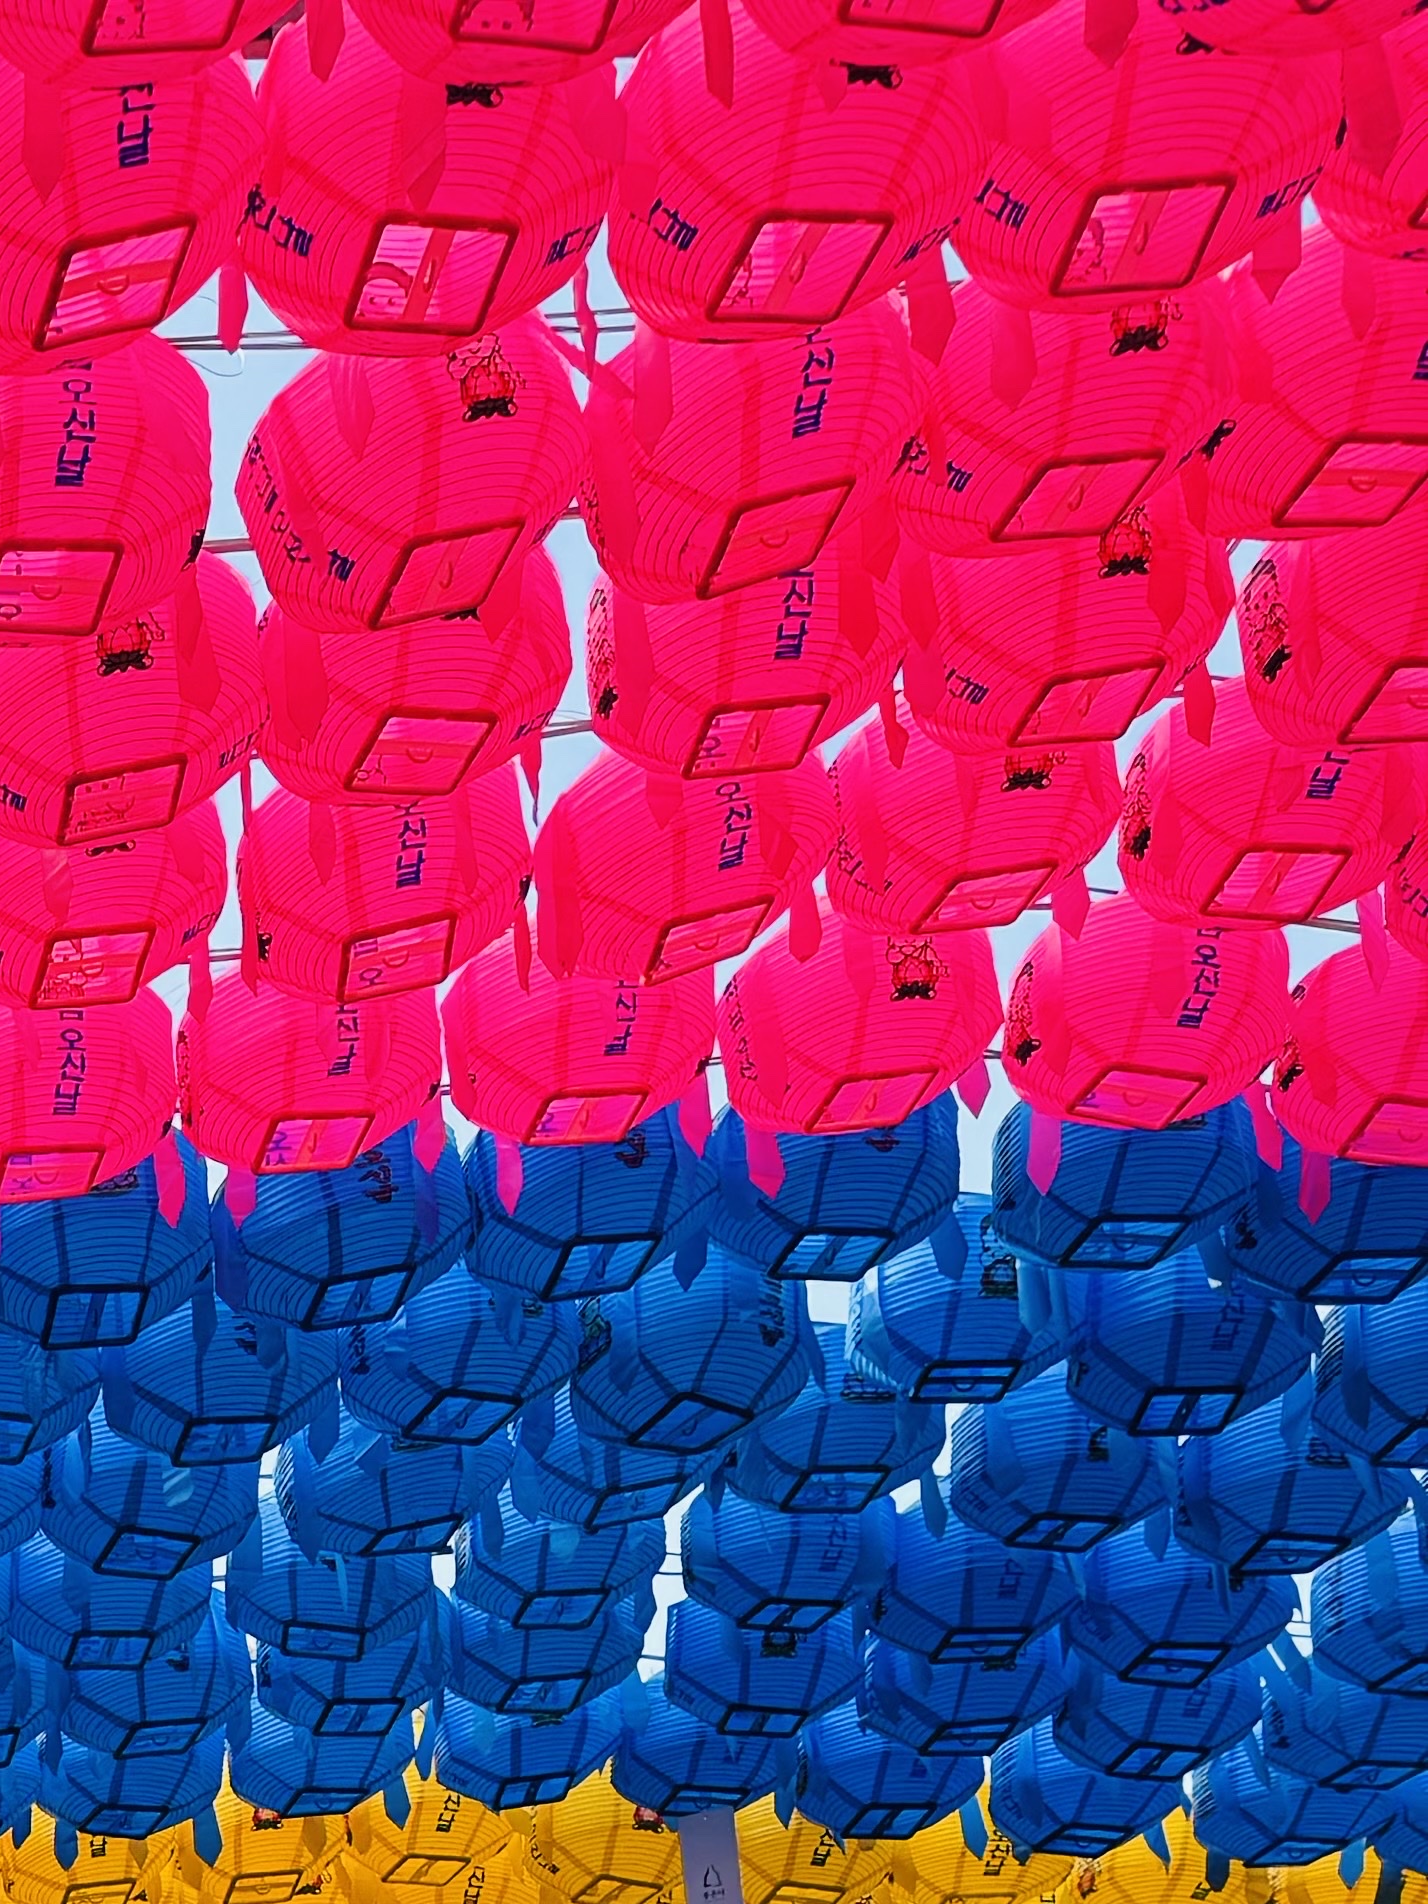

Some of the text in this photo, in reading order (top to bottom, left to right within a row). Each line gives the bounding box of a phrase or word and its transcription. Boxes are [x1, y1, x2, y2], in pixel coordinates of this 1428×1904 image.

[117, 83, 154, 168] 신날
[55, 381, 96, 486] 오신날
[775, 574, 814, 659] 신날
[716, 783, 752, 871] 오신날
[1177, 945, 1221, 1028] 오신날
[53, 1029, 86, 1115] 오신날
